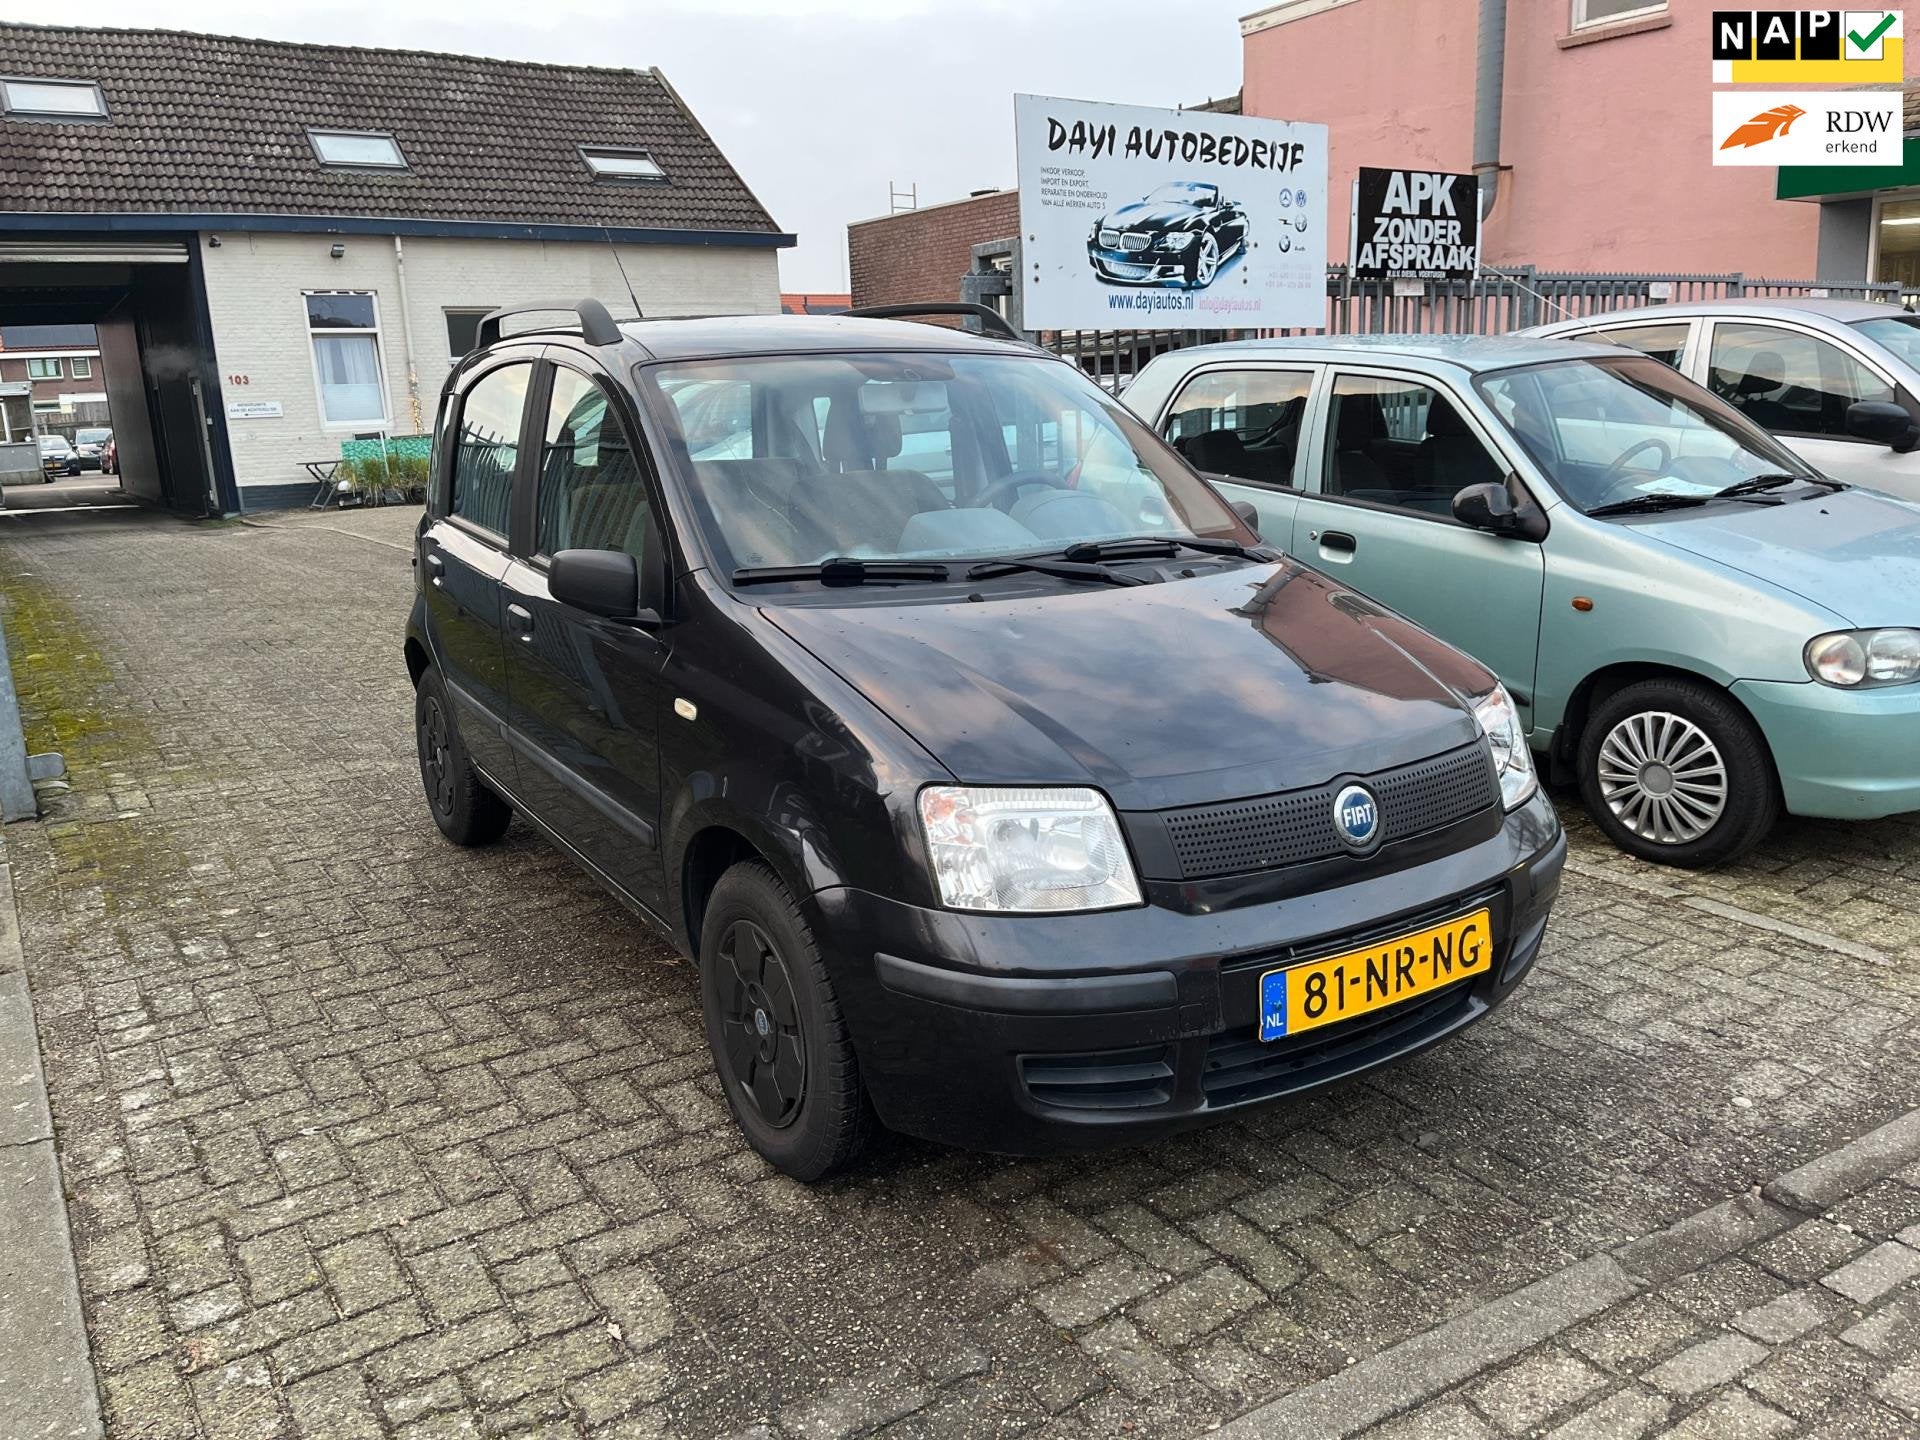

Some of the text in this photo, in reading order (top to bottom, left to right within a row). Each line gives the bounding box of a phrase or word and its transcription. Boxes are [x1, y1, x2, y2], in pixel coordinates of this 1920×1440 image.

[1048, 117, 1304, 173] DAYI AUTOBEDRIJF
[1382, 171, 1457, 216] APK
[1373, 217, 1461, 245] ZONDER
[1357, 242, 1475, 270] AFSPRAAK
[1108, 291, 1194, 314] www.dayiautos.nl
[228, 375, 249, 385] 103
[1343, 803, 1372, 828] FIAT
[1303, 924, 1479, 1019] 81-NR-NG
[1266, 1012, 1284, 1029] NL
